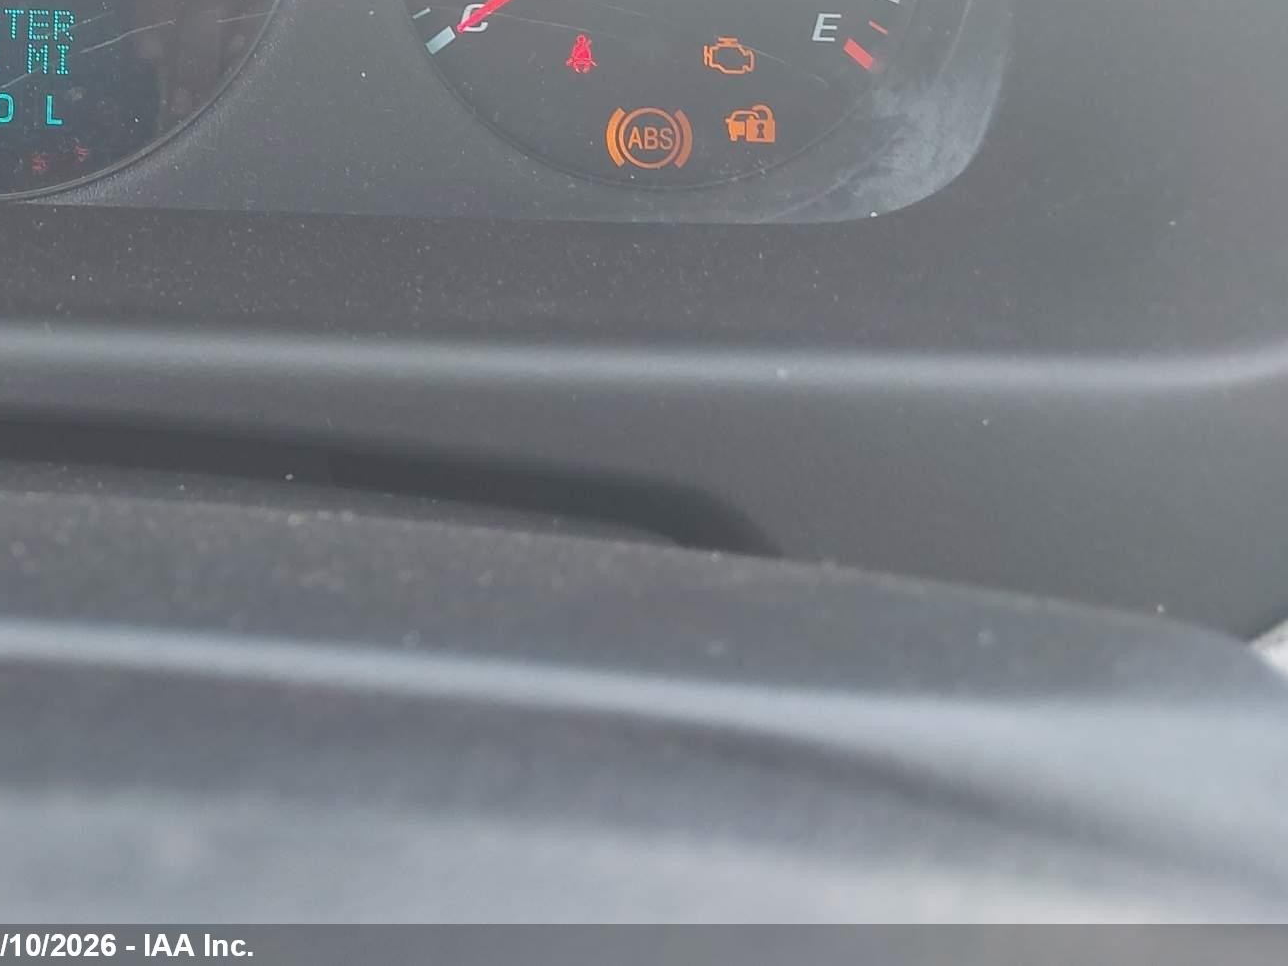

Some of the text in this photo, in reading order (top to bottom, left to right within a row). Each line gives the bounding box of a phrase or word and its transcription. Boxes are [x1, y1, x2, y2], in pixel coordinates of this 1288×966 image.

[812, 13, 842, 42] E
[27, 44, 70, 75] MI
[46, 96, 64, 125] L
[627, 125, 674, 150] ABS
